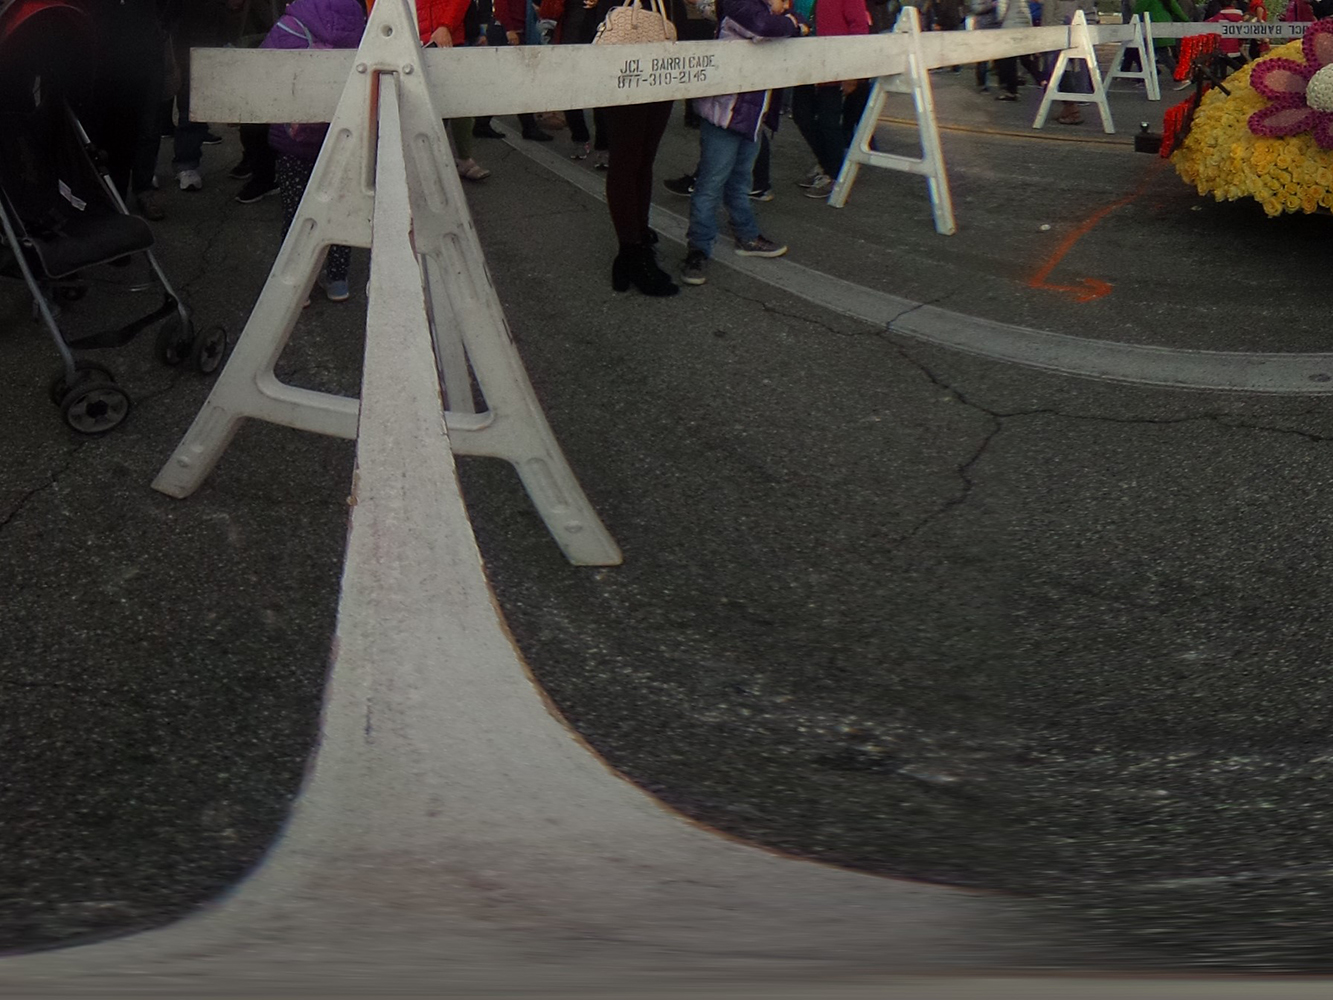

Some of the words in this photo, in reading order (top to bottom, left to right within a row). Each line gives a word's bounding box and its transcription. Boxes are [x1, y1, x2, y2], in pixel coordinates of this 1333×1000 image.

[1222, 25, 1282, 35] BARRICADE
[620, 59, 643, 74] JCL
[651, 54, 715, 72] BARRICADE
